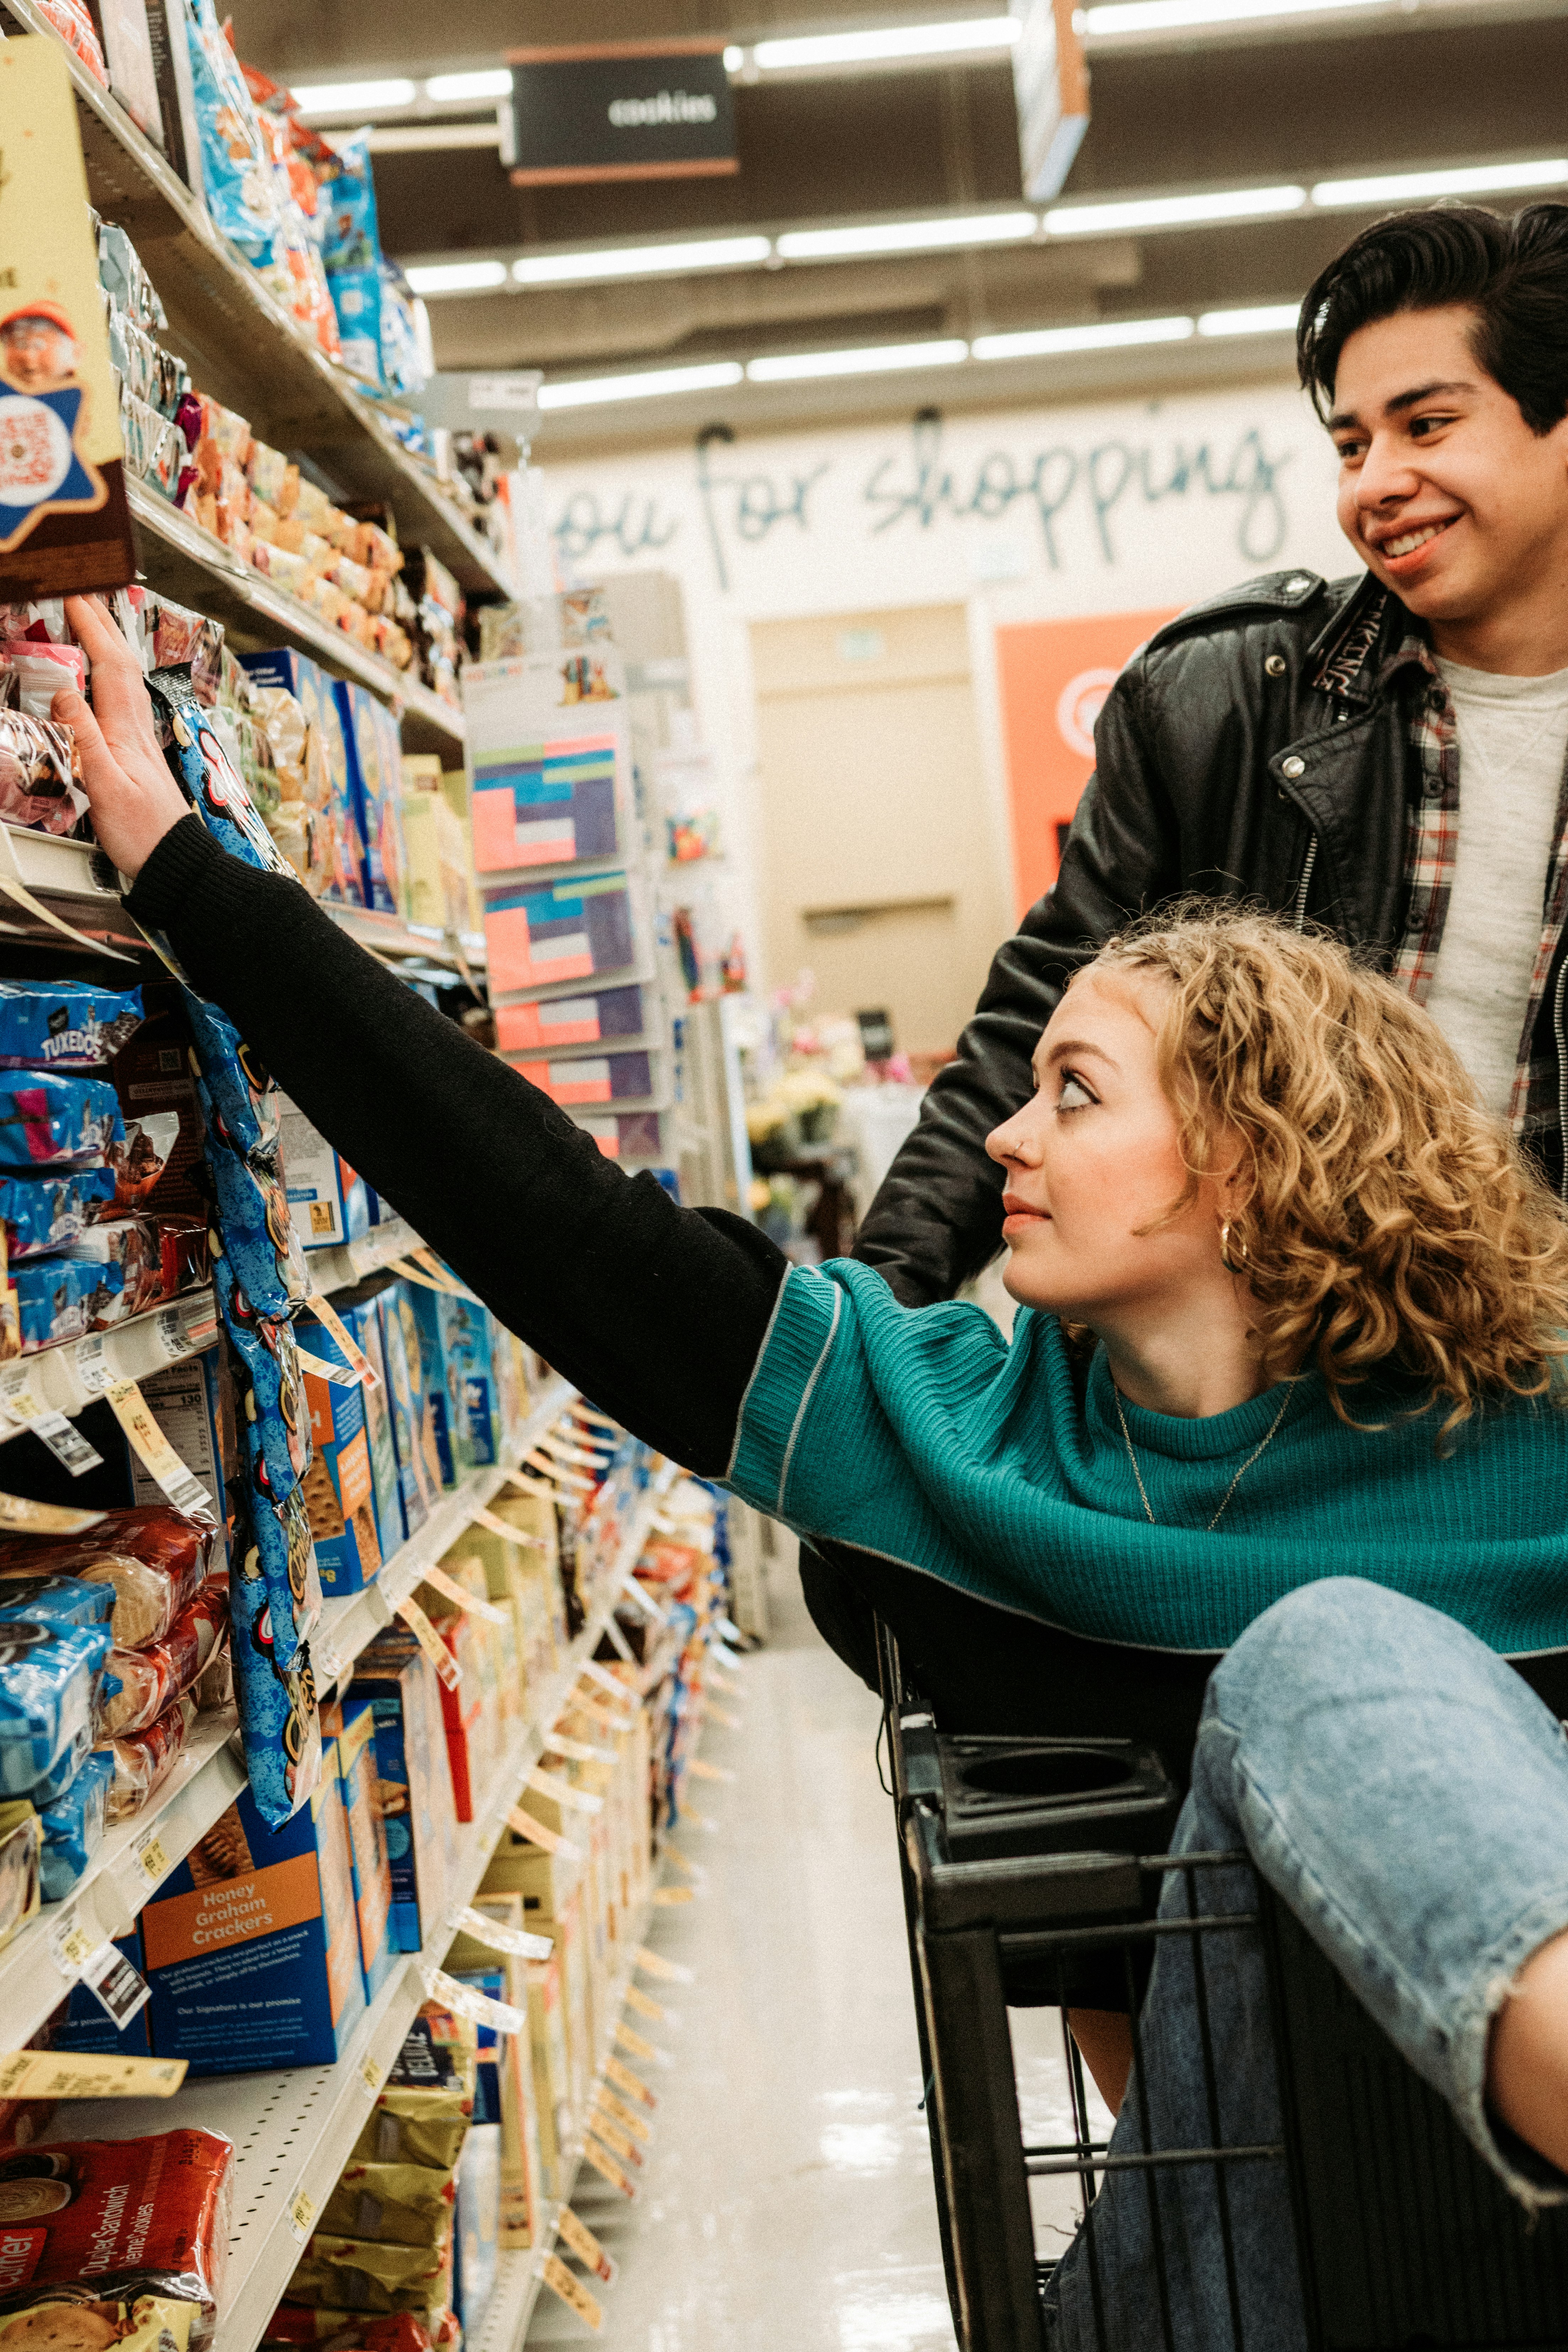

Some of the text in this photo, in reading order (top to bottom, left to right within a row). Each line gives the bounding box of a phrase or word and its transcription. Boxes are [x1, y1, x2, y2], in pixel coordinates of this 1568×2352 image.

[607, 88, 718, 127] cookies
[554, 402, 1292, 592] ou for shopping
[41, 1029, 102, 1061] TUXEDOS
[180, 1394, 201, 1404] 130
[196, 1897, 266, 1926] Graham
[204, 1883, 255, 1907] Honey
[193, 1911, 273, 1945] Crackers
[196, 2004, 237, 2014] Signature
[265, 1997, 301, 2008] promise
[79, 2184, 130, 2275] Duplex Sandwich
[126, 2203, 155, 2240] Cookies
